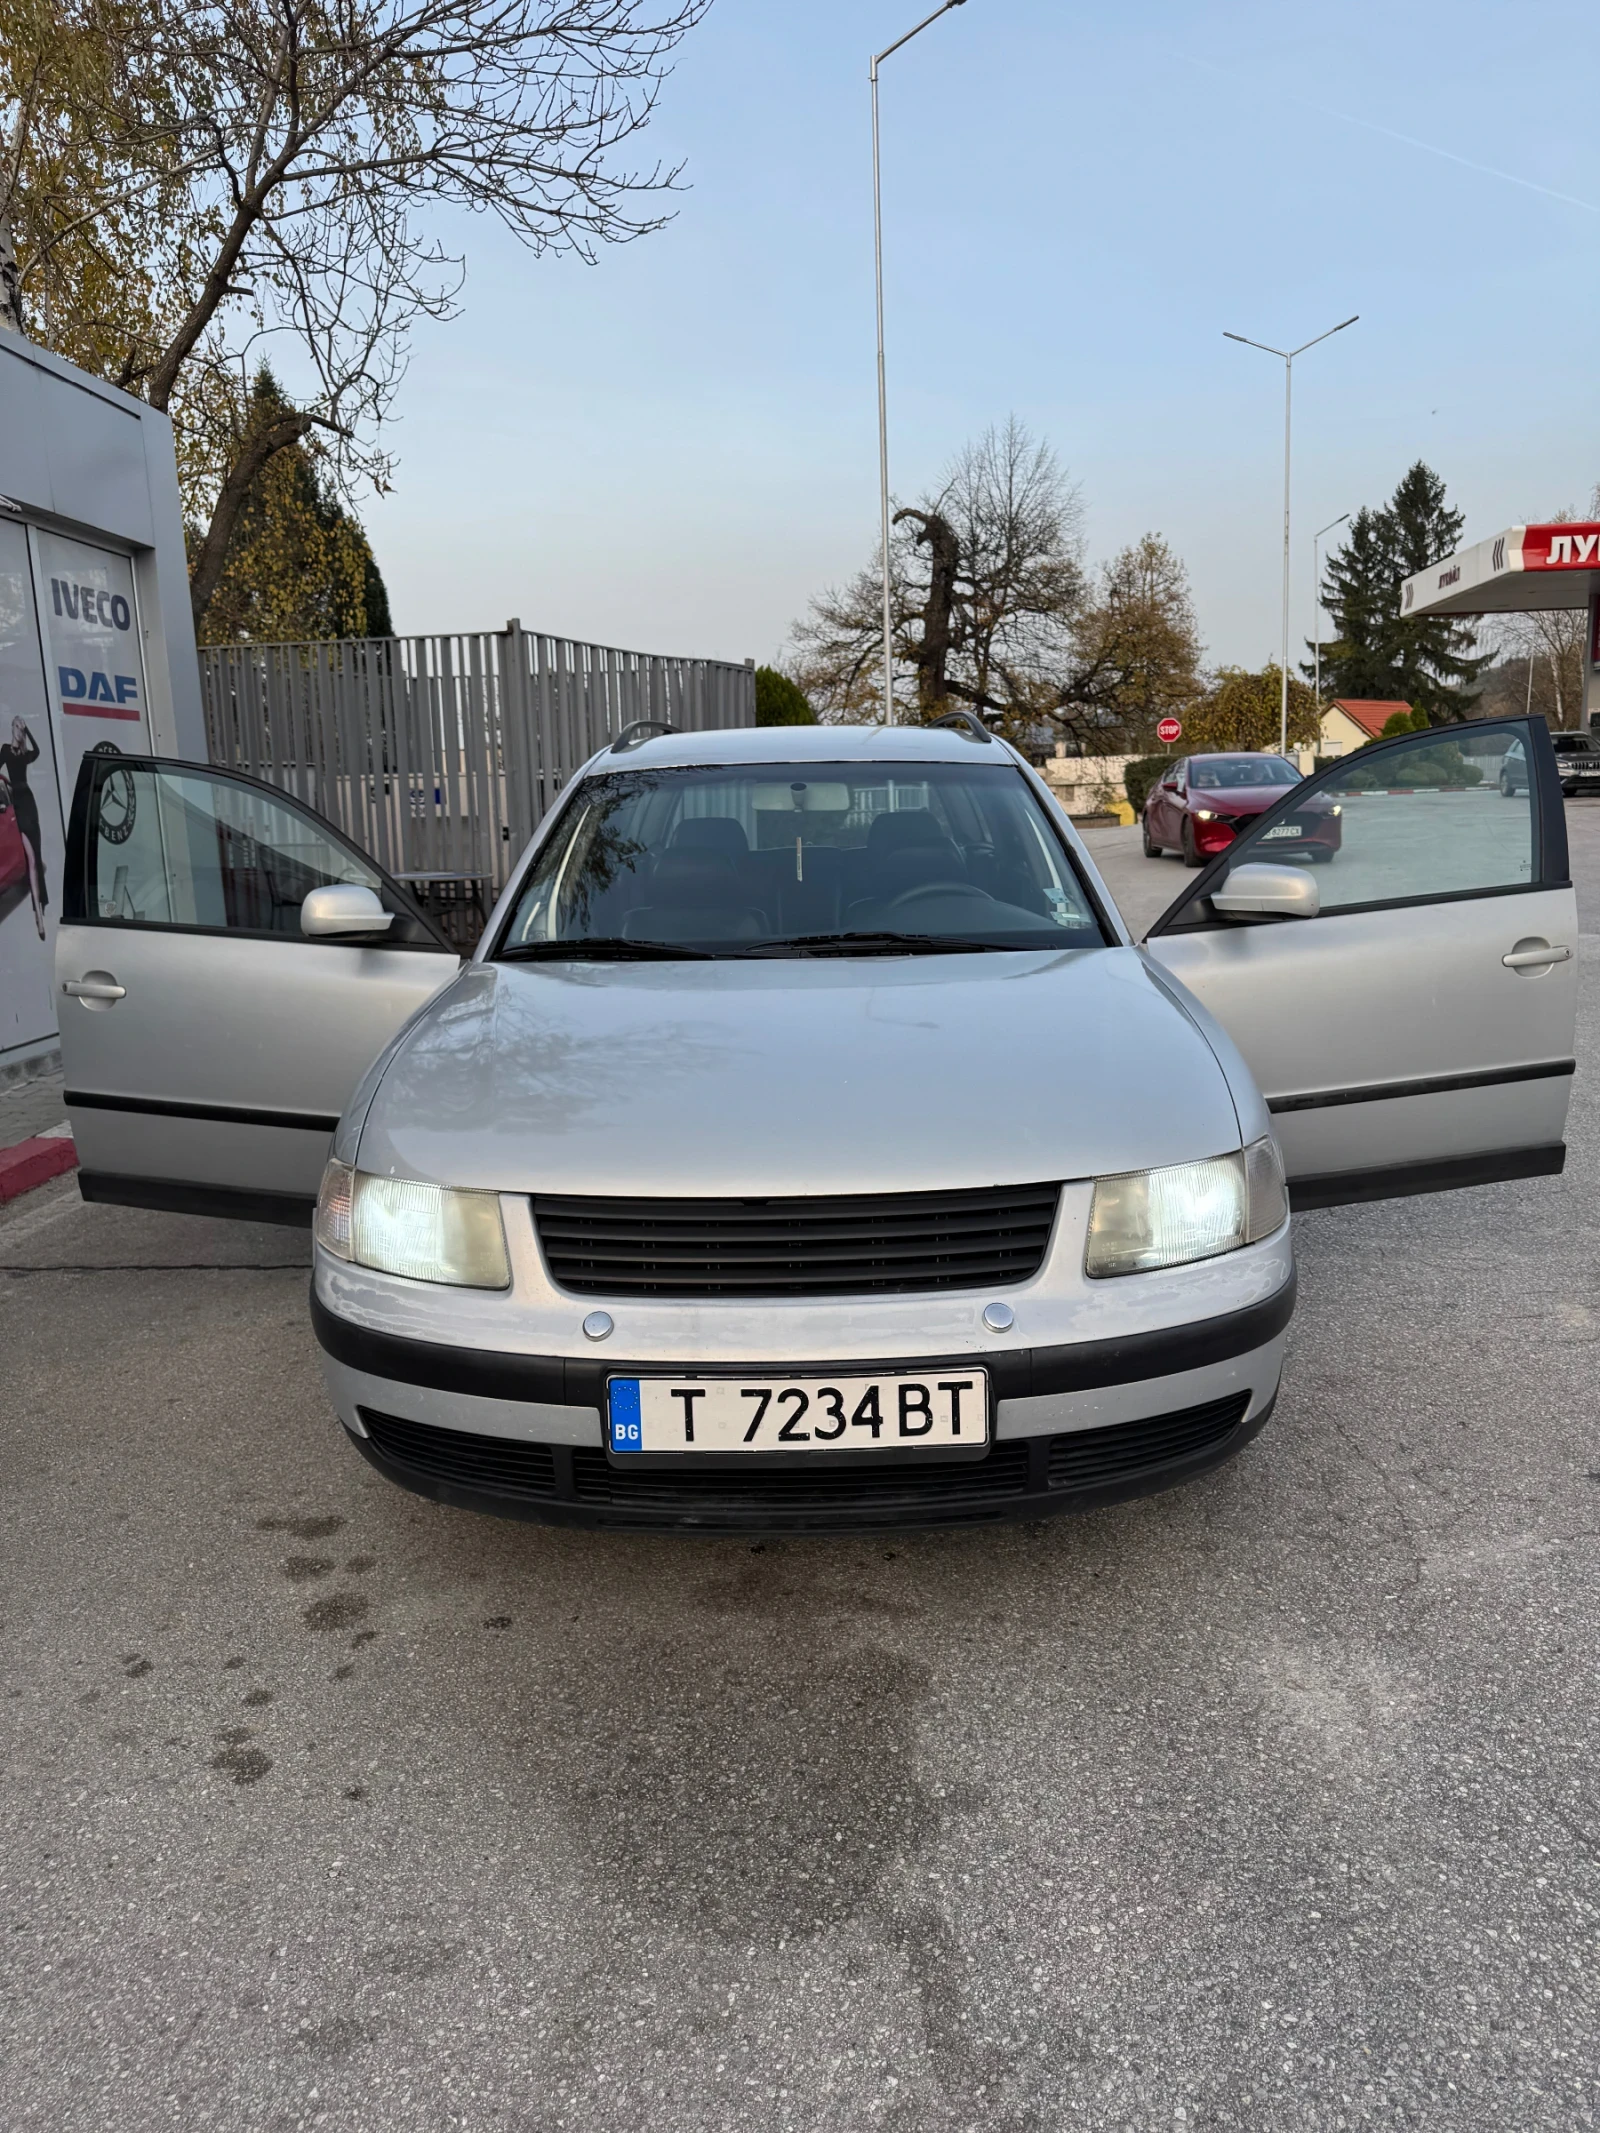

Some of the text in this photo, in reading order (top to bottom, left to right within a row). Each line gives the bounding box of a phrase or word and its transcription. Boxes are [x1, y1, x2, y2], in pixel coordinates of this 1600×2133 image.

[1546, 534, 1600, 565] ЛУ
[50, 577, 131, 632] IVECO
[58, 665, 138, 704] DAF
[1160, 725, 1179, 735] STOP
[614, 1423, 639, 1441] BG
